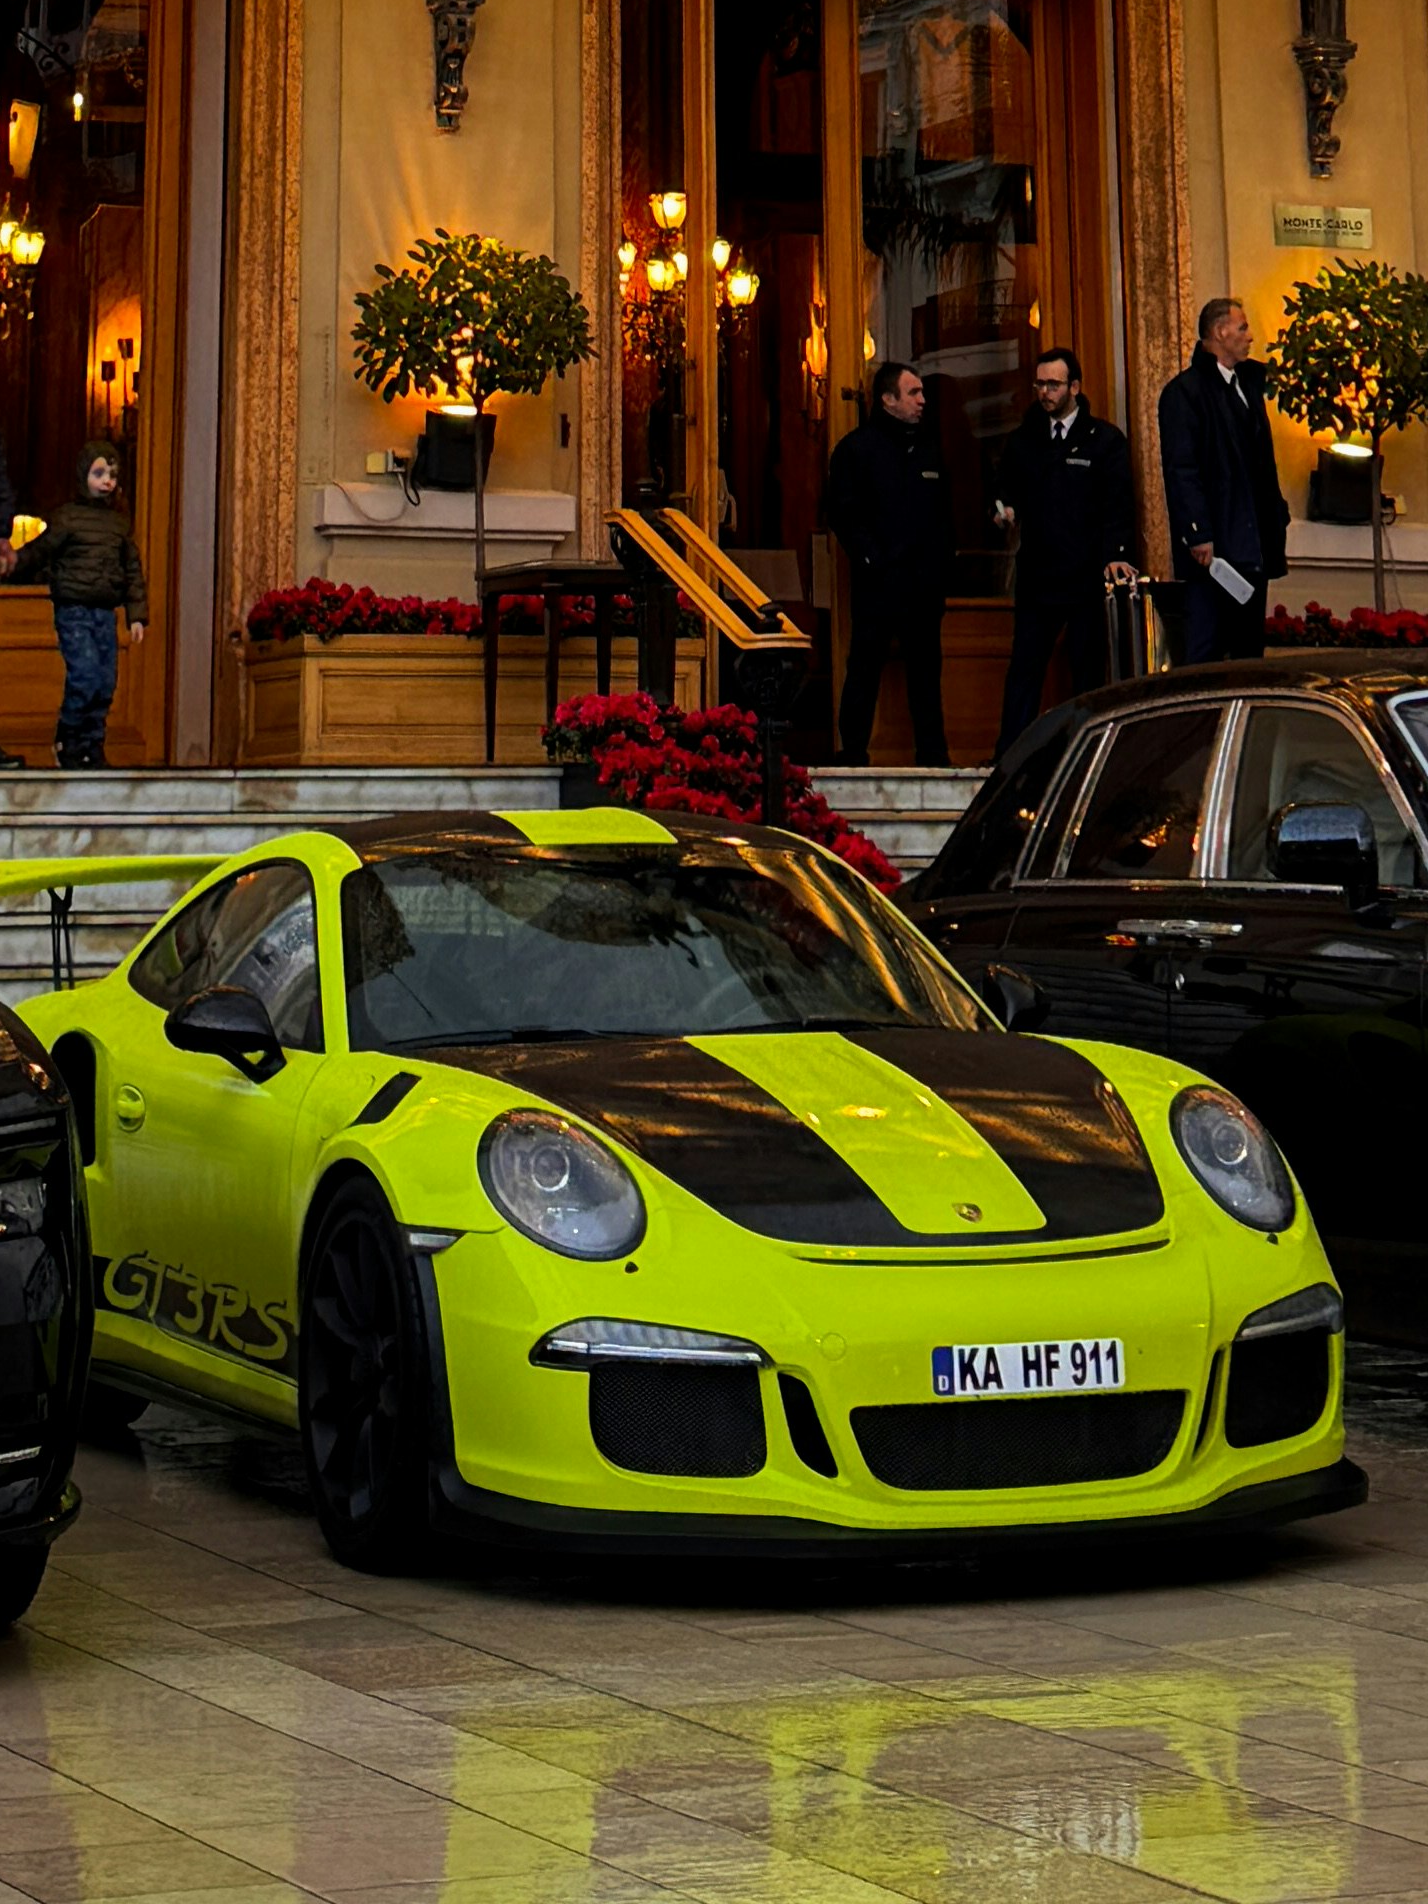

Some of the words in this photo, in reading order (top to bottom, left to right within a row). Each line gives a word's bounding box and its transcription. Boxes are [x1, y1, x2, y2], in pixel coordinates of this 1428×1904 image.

[1283, 217, 1363, 230] MONTE-CARLO
[958, 1347, 1004, 1392] KA
[1022, 1344, 1060, 1389] HF
[1071, 1340, 1120, 1387] 911
